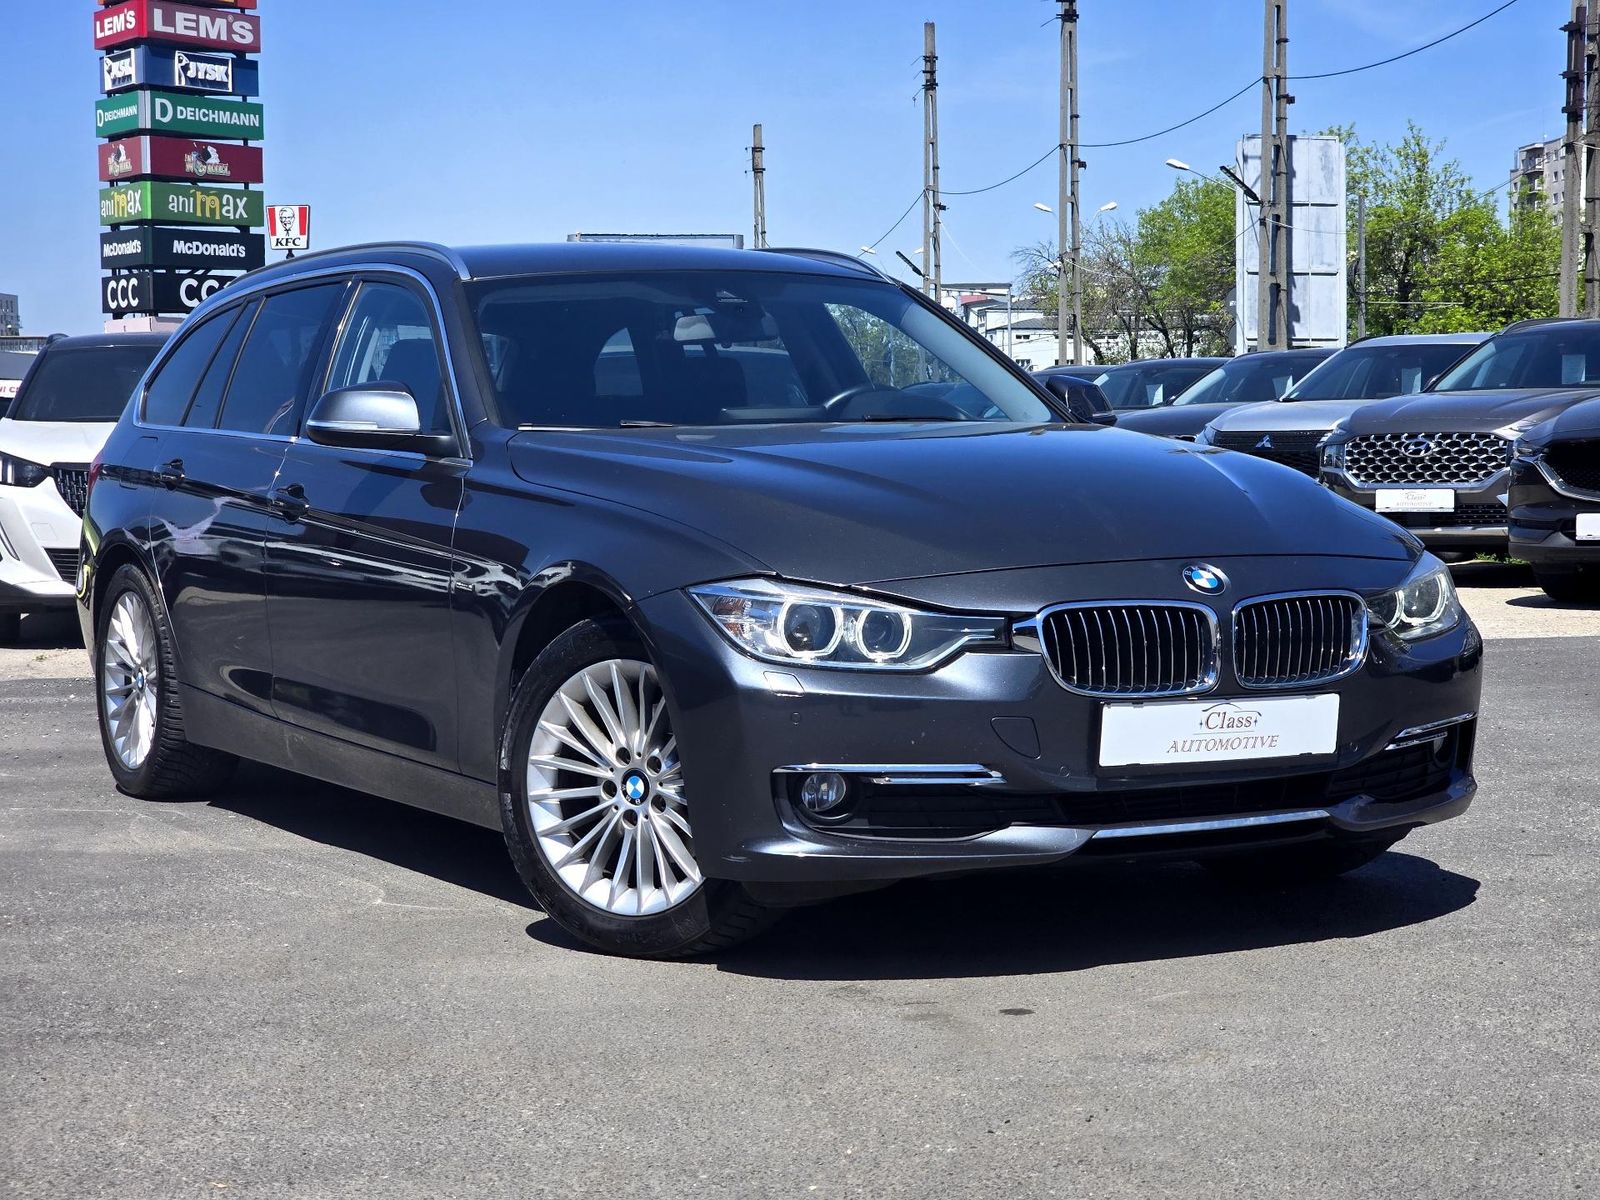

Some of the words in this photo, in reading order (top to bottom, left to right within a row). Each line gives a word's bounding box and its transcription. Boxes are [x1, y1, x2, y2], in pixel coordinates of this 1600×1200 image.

[96, 8, 136, 39] LEM'S
[187, 61, 228, 82] JYSK
[105, 104, 137, 121] DEICHMANN
[177, 106, 259, 127] DEICHMANN
[101, 189, 142, 218] animax
[168, 189, 248, 219] animax
[103, 239, 142, 258] McDonald's
[172, 240, 246, 258] McDonald's
[275, 237, 301, 247] KFC
[107, 277, 139, 309] CCC
[180, 278, 232, 308] CC
[1204, 711, 1253, 730] Class
[1166, 735, 1280, 754] AUTOMOTIVE
